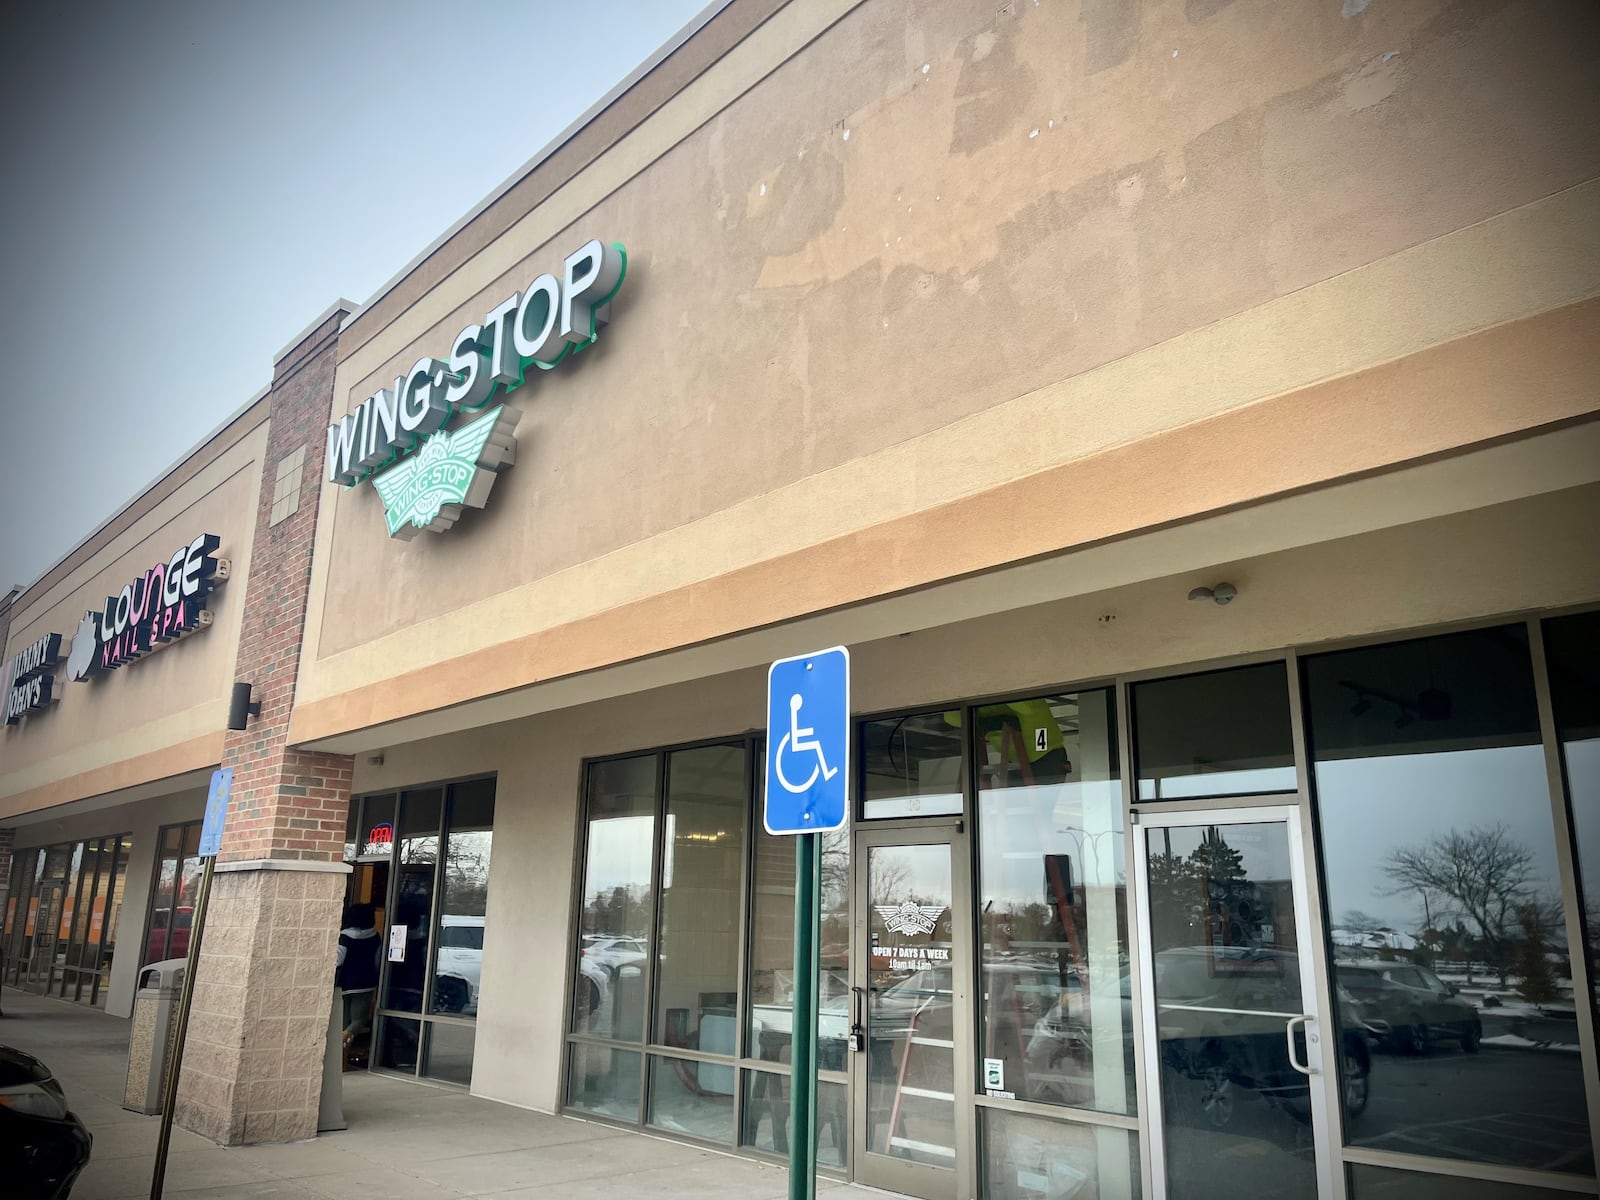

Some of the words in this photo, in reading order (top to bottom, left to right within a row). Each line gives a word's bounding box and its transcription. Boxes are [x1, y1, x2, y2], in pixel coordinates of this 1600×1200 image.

[101, 533, 206, 643] LOUNGE
[12, 632, 51, 687] JIMMY
[101, 626, 138, 669] NAIL
[150, 600, 186, 642] SPA
[5, 674, 43, 726] JOHN'S
[1036, 729, 1046, 750] 4
[370, 828, 392, 844] OPEN
[873, 947, 892, 957] OPEN
[893, 948, 898, 957] 7
[899, 948, 918, 958] DAYS
[919, 949, 925, 958] A
[927, 949, 948, 959] WEEK
